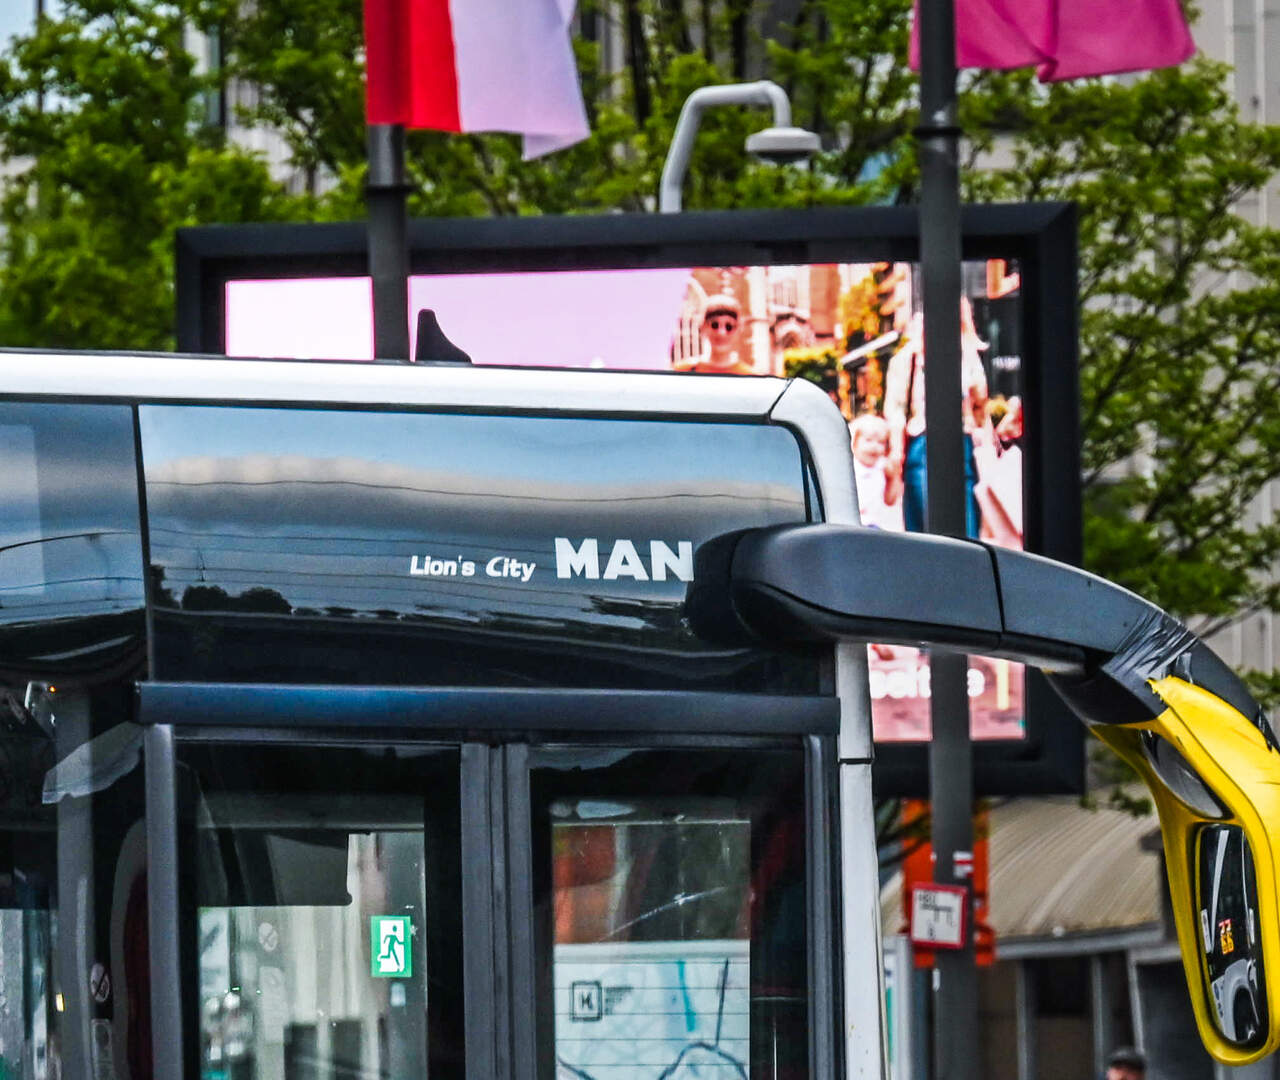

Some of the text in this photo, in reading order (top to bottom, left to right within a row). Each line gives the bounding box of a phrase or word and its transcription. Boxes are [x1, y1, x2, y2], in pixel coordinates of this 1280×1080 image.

[410, 555, 536, 582] Lion's City
[554, 537, 695, 582] MAN
